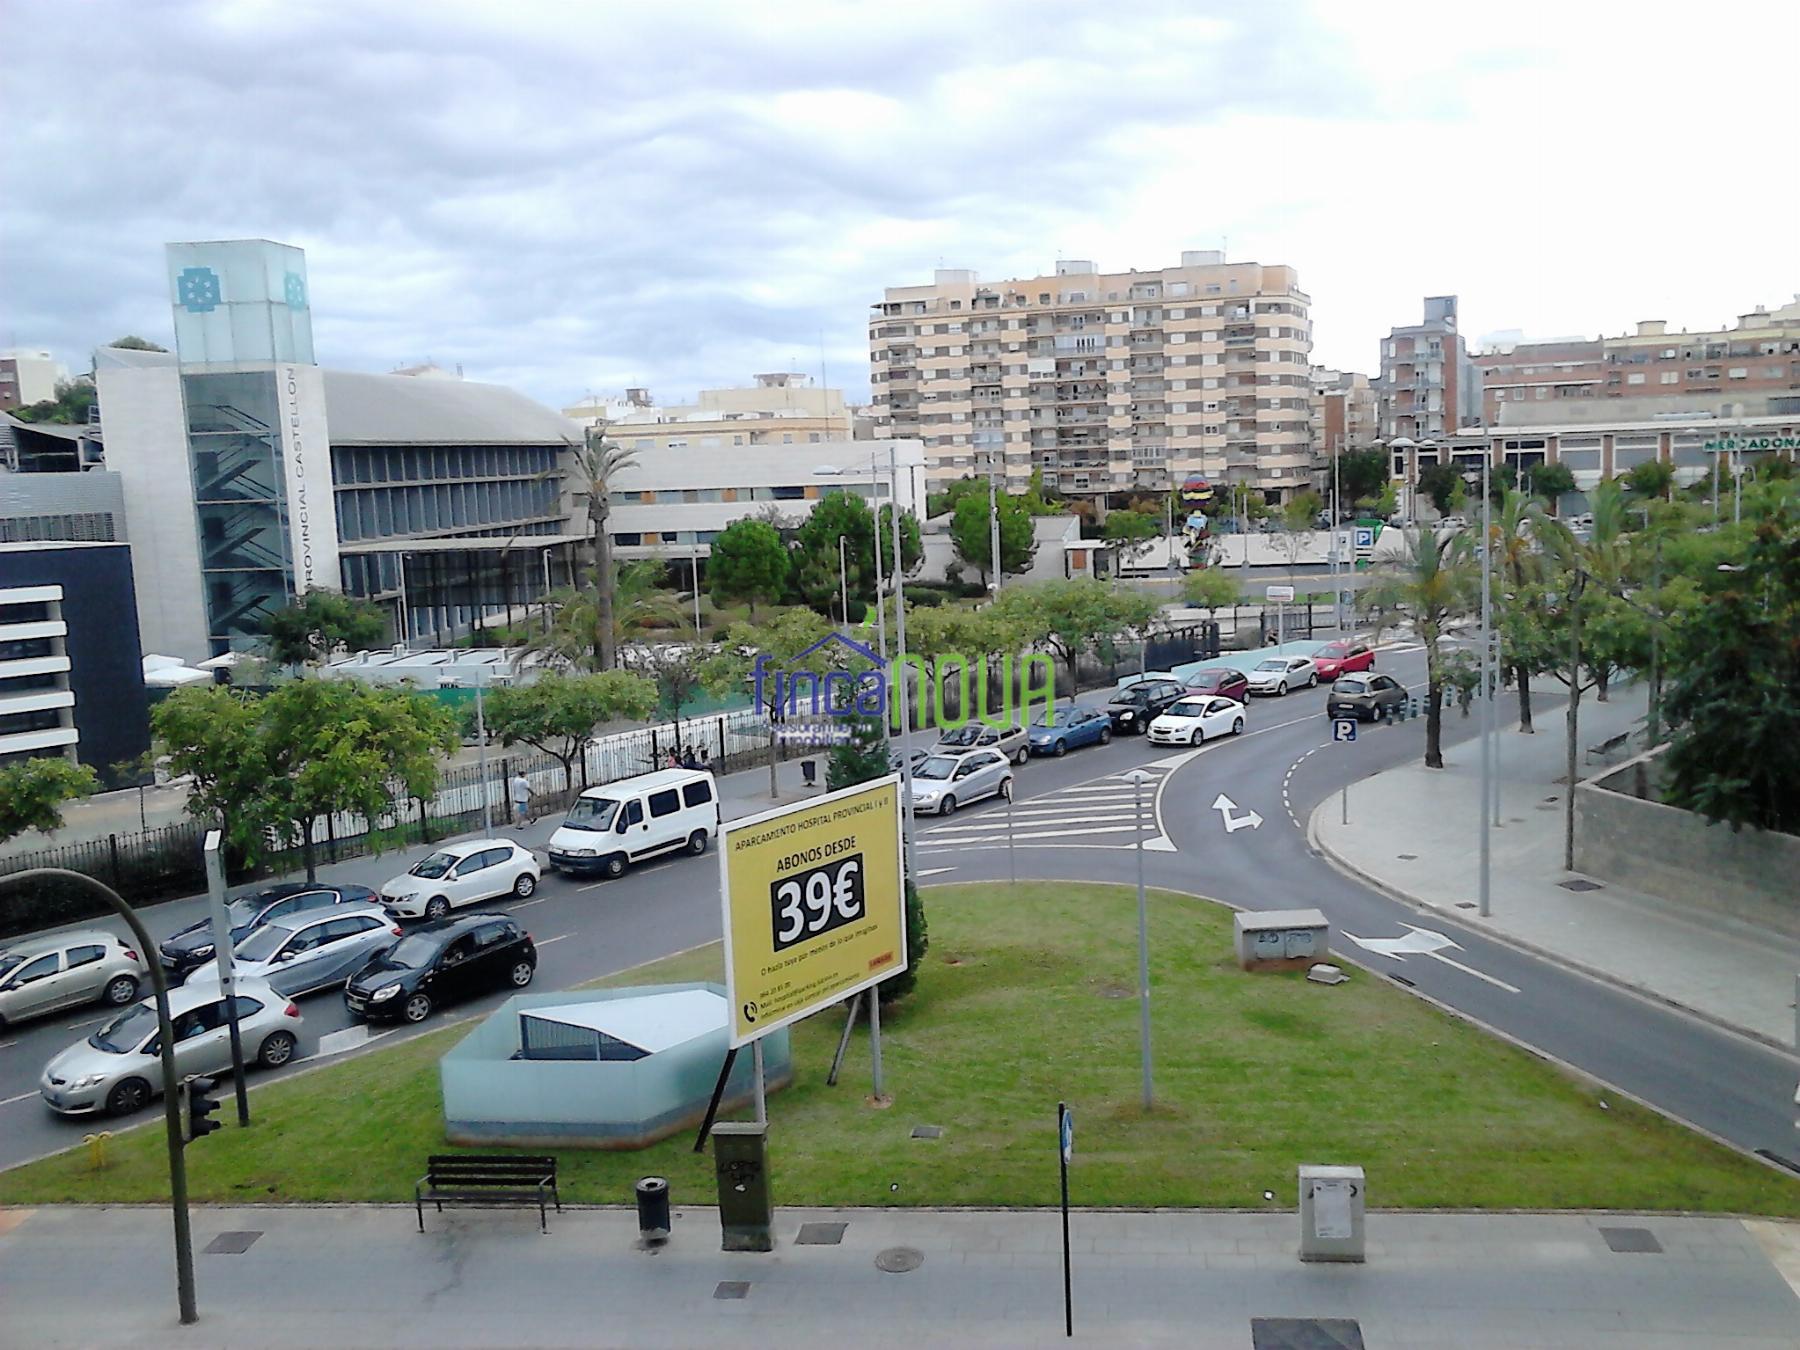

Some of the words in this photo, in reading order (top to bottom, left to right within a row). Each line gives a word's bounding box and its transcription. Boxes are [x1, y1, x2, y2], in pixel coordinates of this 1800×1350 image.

[286, 367, 304, 479] CASTELLON
[298, 483, 314, 587] ROVINCIAL
[1358, 531, 1370, 546] P
[1336, 721, 1353, 740] P
[735, 824, 796, 851] APARCAMIENTO
[797, 815, 831, 831] HOSPITAL
[833, 801, 873, 820] PROVINCIAL
[776, 847, 822, 873] ABONOS
[825, 836, 857, 857] DESDE
[778, 860, 860, 943] 39€
